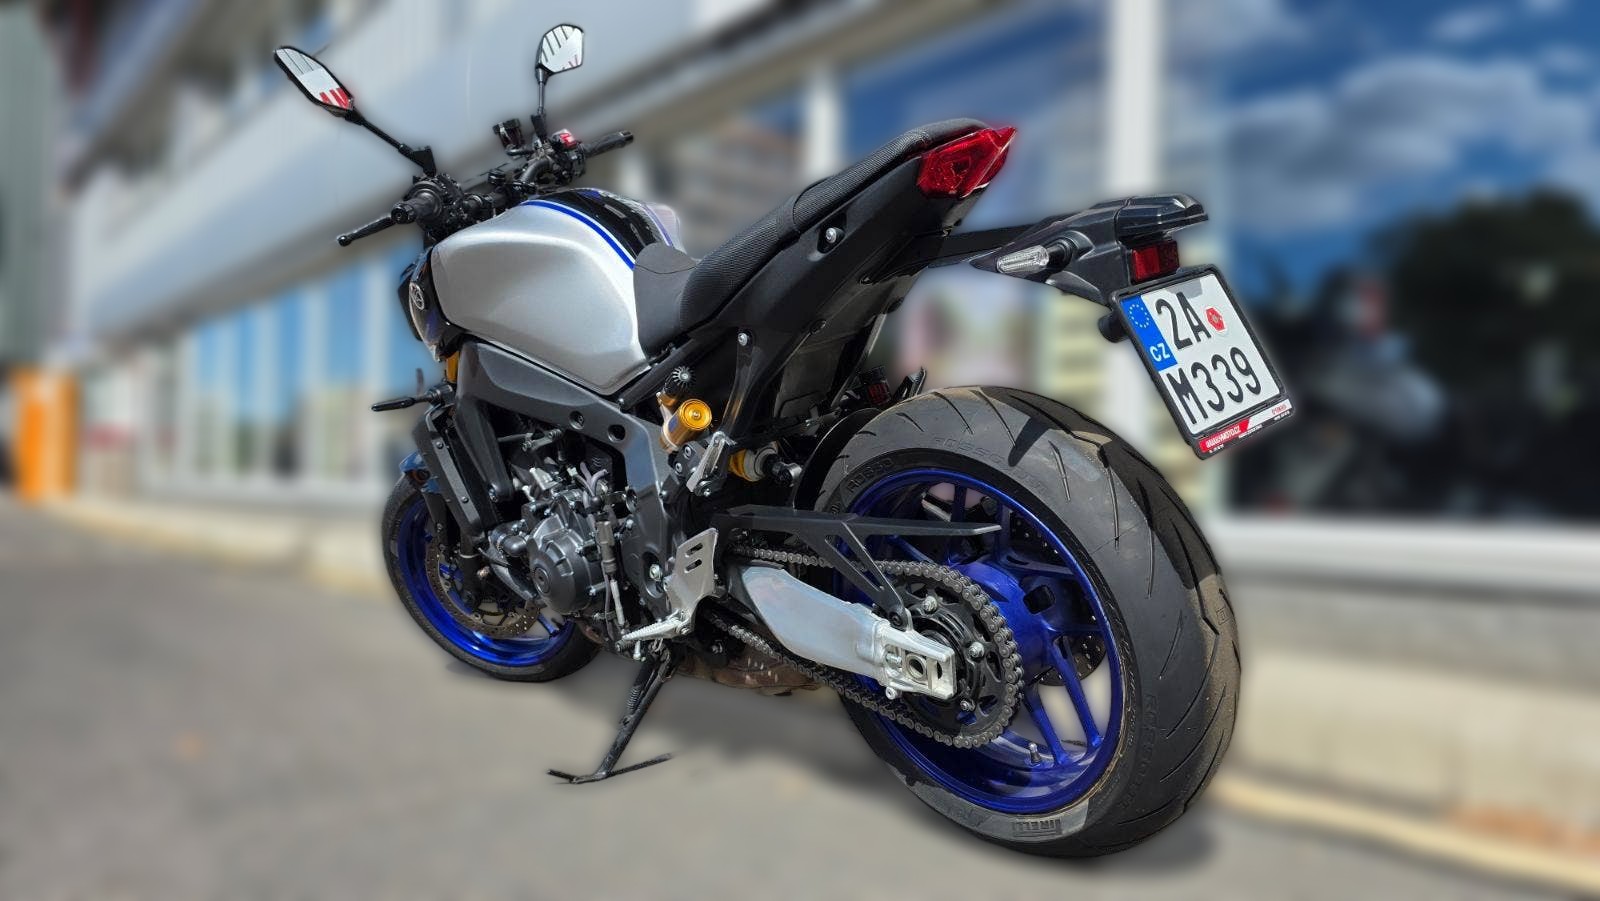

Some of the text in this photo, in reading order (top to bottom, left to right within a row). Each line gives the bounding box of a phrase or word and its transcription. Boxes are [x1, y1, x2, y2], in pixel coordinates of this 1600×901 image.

[1154, 291, 1212, 350] 2A
[1150, 342, 1171, 362] CZ
[1166, 346, 1262, 425] M339
